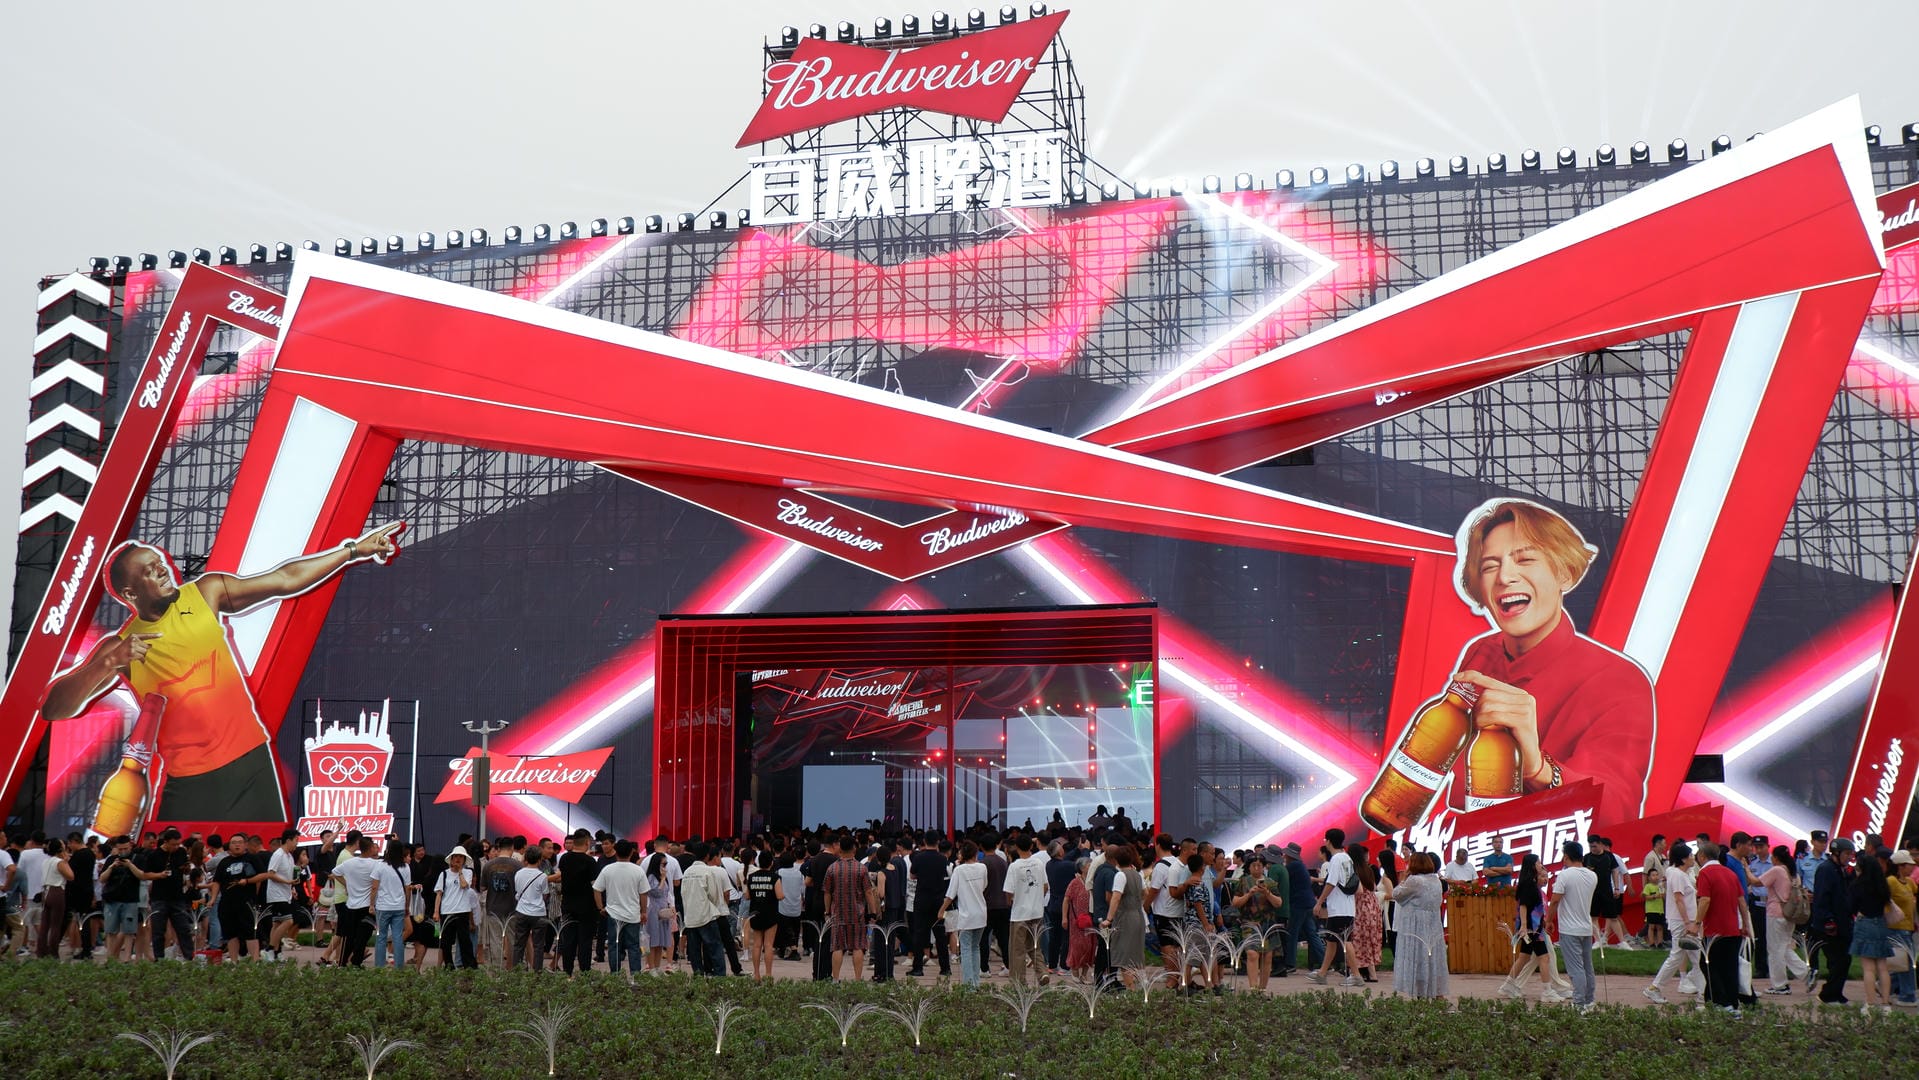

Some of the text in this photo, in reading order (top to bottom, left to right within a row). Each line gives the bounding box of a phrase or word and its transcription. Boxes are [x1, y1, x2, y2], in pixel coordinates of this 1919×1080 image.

[765, 49, 1036, 110] Budweiser
[748, 131, 1063, 226] 百威啤酒
[139, 311, 191, 409] Budweiser
[778, 499, 883, 552] Budweiser
[921, 510, 1030, 556] Budweise
[42, 535, 95, 635] Budweiser
[817, 679, 903, 699] udweiser
[1397, 754, 1440, 783] Budweiser
[307, 788, 384, 817] OLYMPIC
[351, 815, 387, 833] Series
[1470, 799, 1496, 808] Bud
